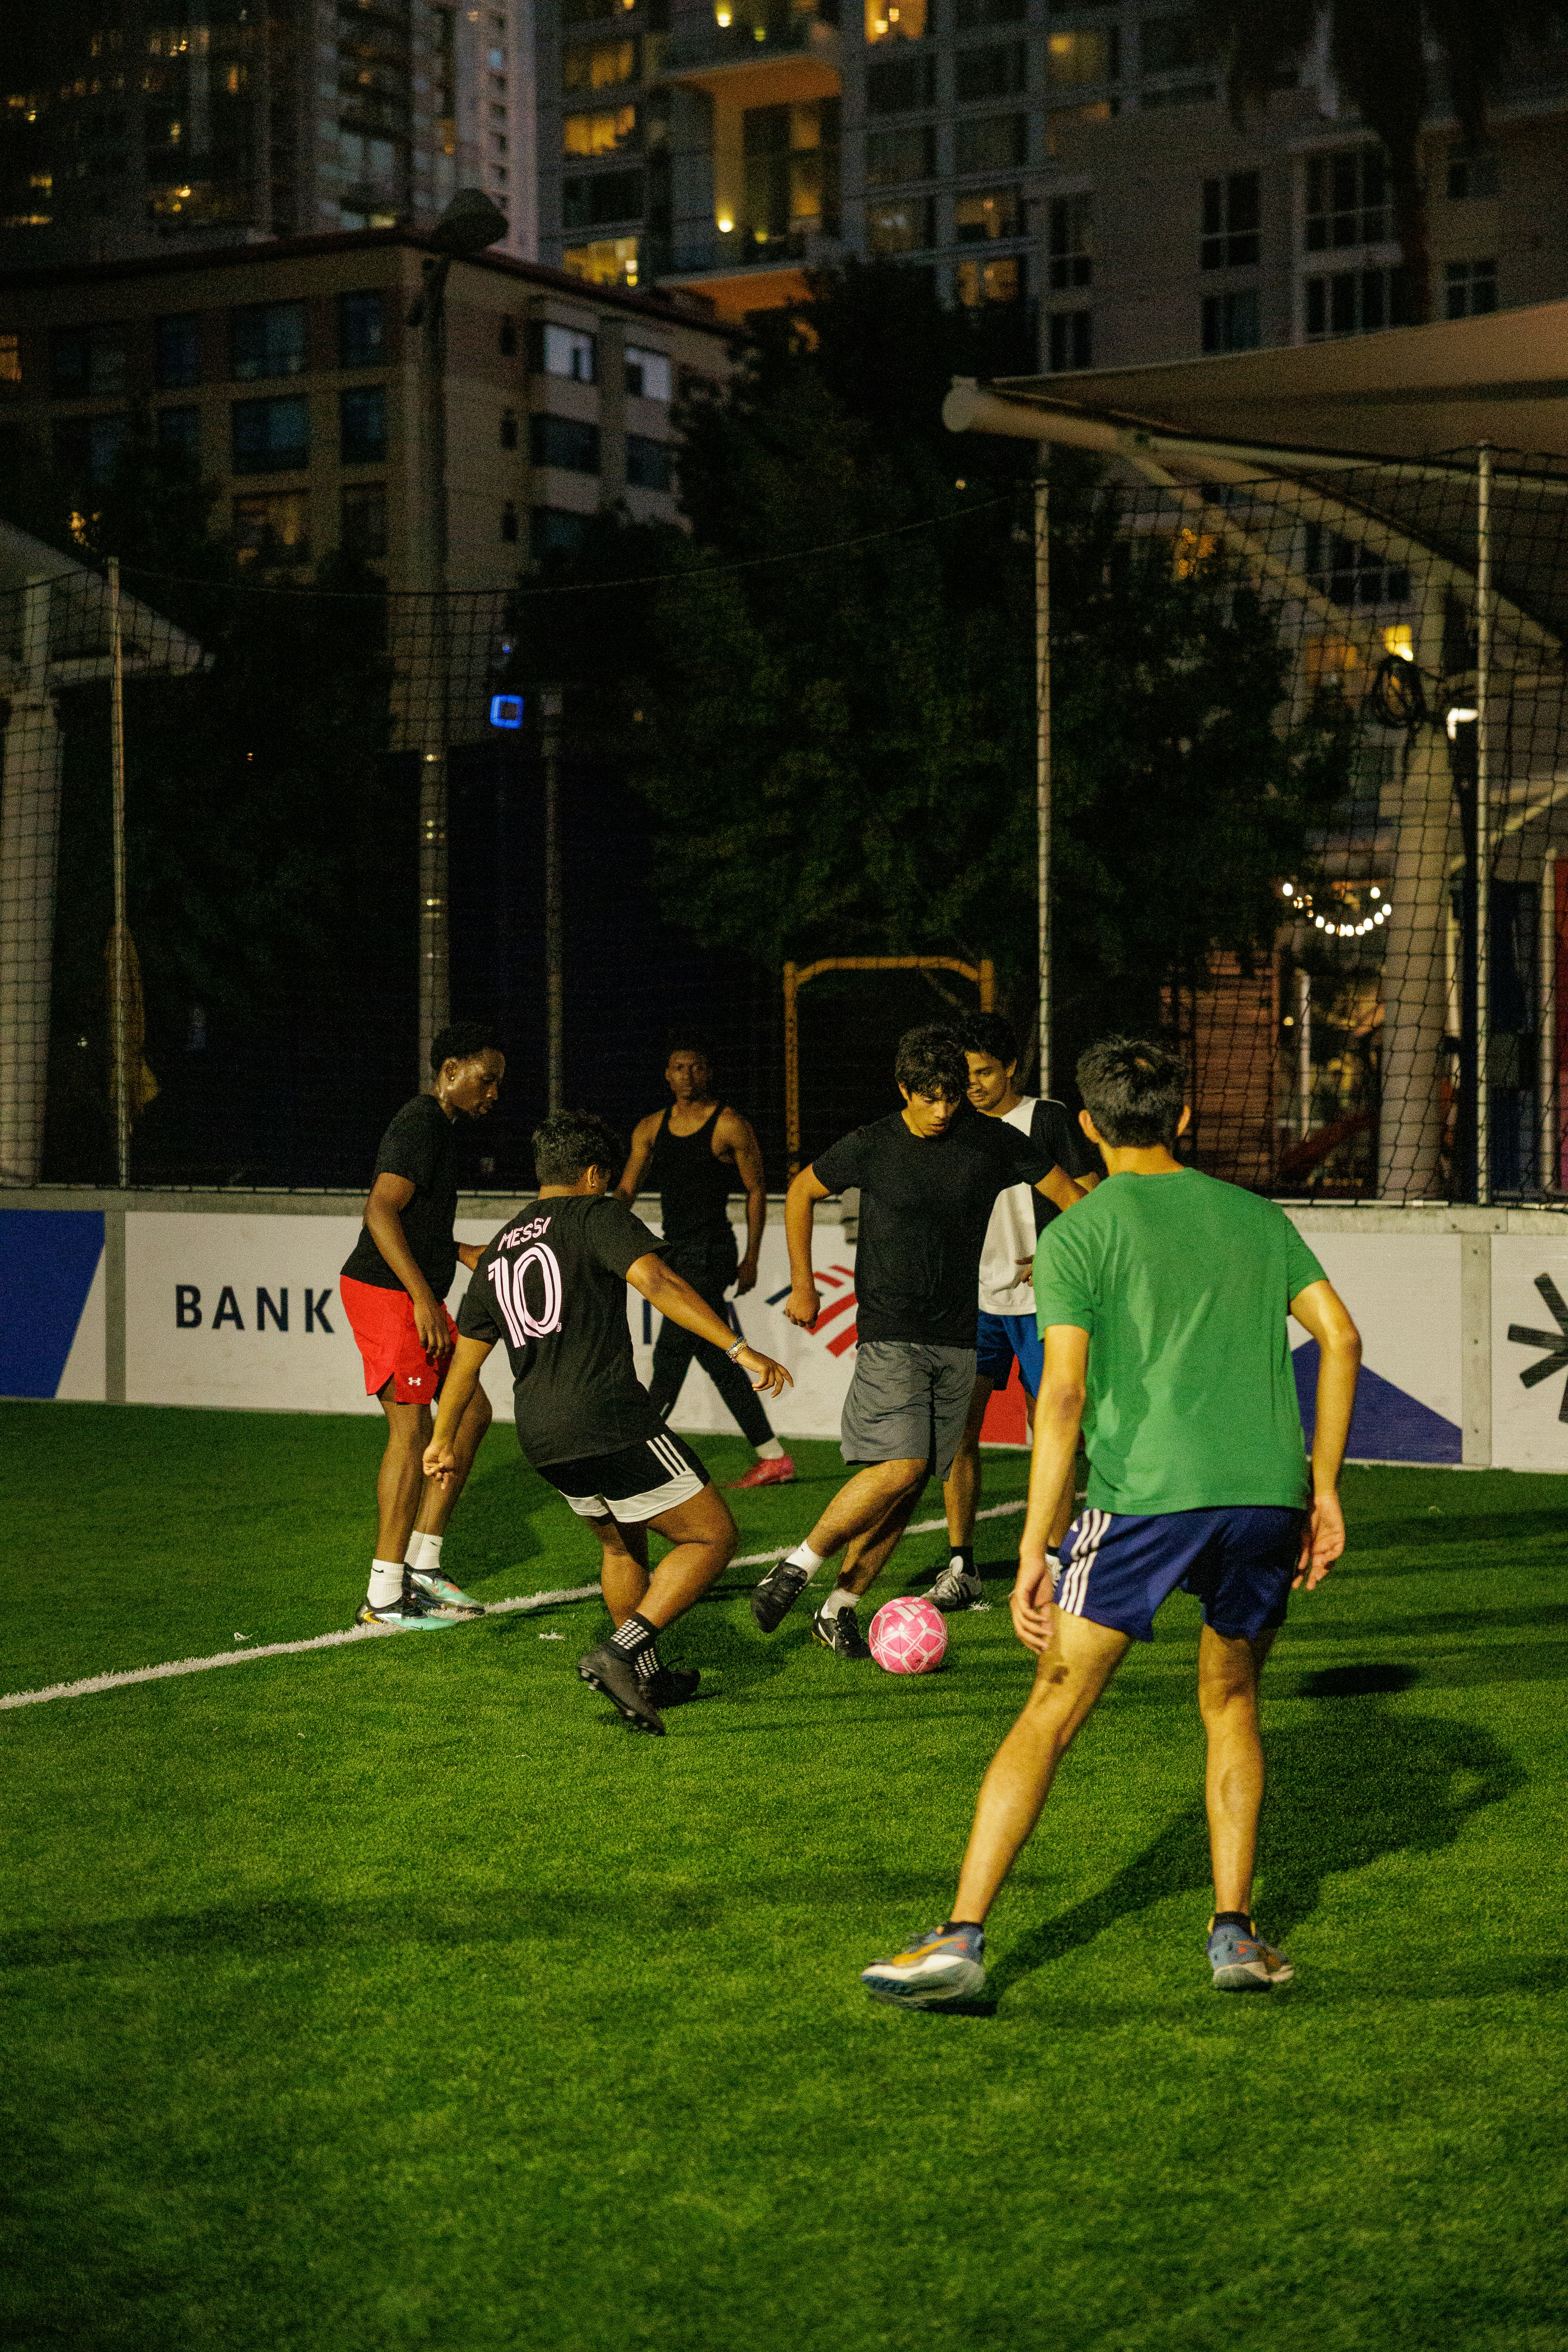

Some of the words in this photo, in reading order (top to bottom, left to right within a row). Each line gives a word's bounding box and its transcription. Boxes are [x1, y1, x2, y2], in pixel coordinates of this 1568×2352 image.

[497, 1217, 551, 1251] MESSI
[175, 1284, 334, 1333] BANK
[488, 1242, 562, 1348] 10
